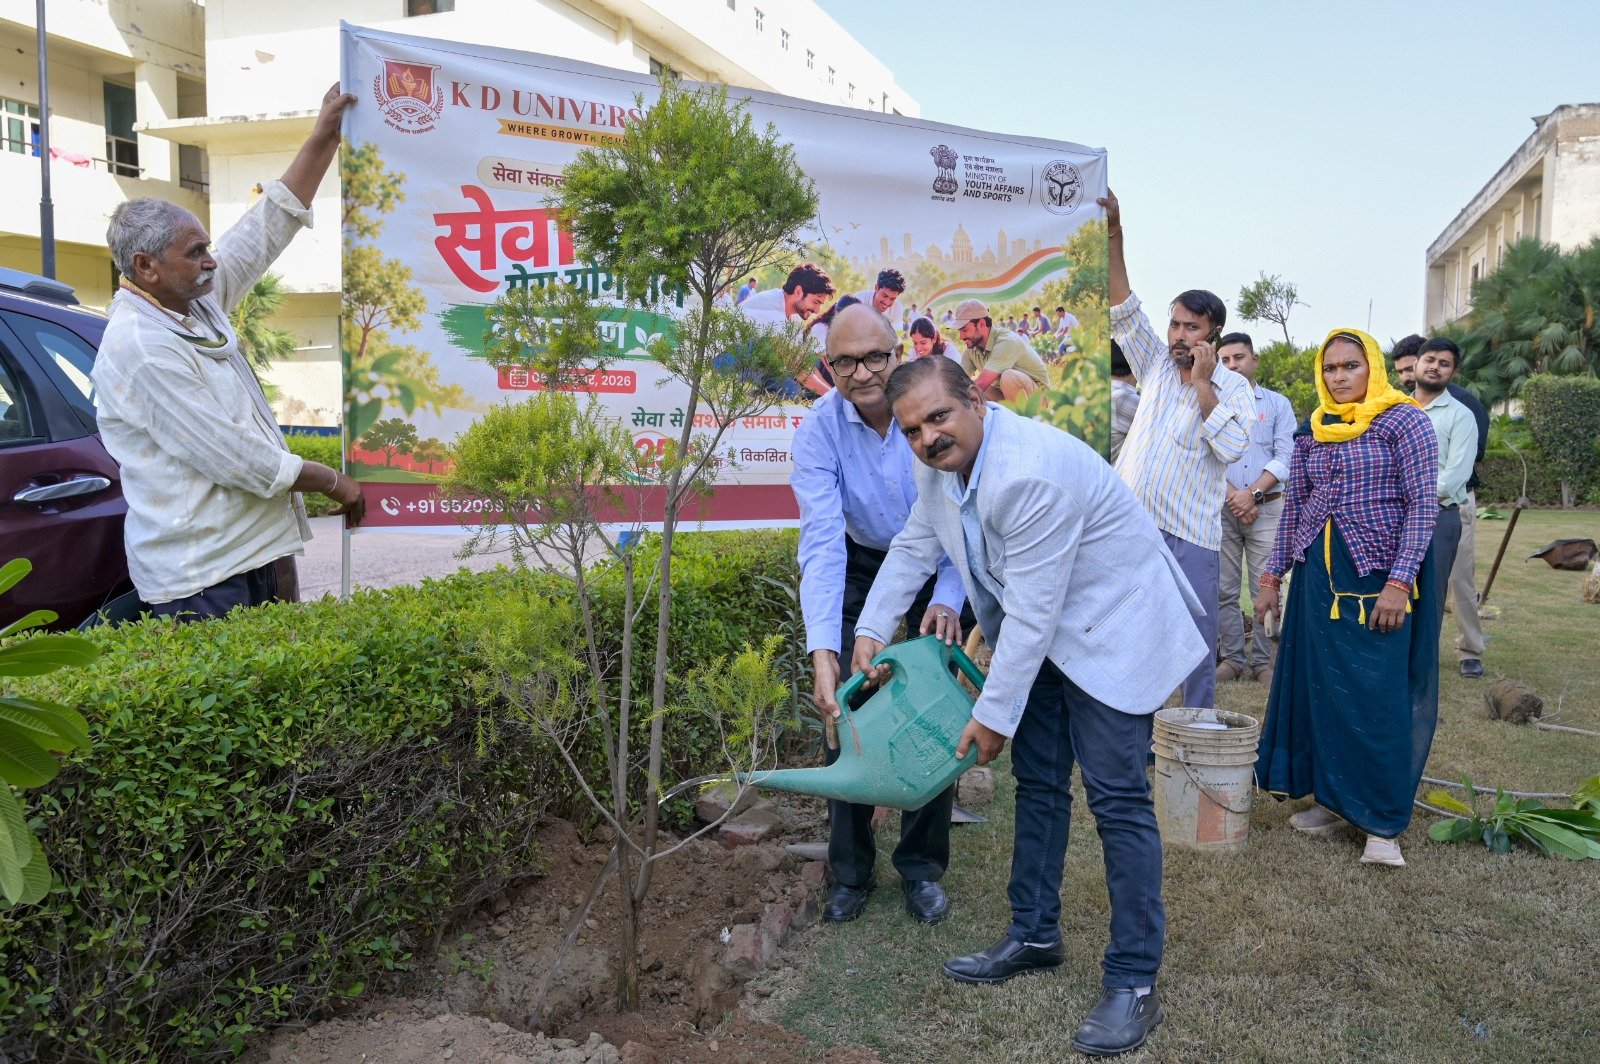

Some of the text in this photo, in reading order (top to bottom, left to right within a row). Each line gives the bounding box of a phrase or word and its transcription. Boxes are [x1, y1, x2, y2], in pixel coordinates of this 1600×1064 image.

[451, 81, 650, 130] K D UNIVERS
[507, 123, 547, 137] WHERE
[551, 130, 597, 143] GROWTH
[493, 162, 522, 184] सेवा
[965, 172, 1007, 183] MINISTRY OF
[965, 180, 1024, 195] YOUTH AFFAIRS
[963, 189, 1012, 202] AND SPORTS
[433, 185, 574, 292] सेवा
[601, 375, 632, 387] 2026
[631, 407, 665, 428] सेवा
[670, 408, 685, 428] से
[742, 415, 787, 430] समाज
[740, 448, 787, 463] विकसित
[406, 499, 435, 514] +91
